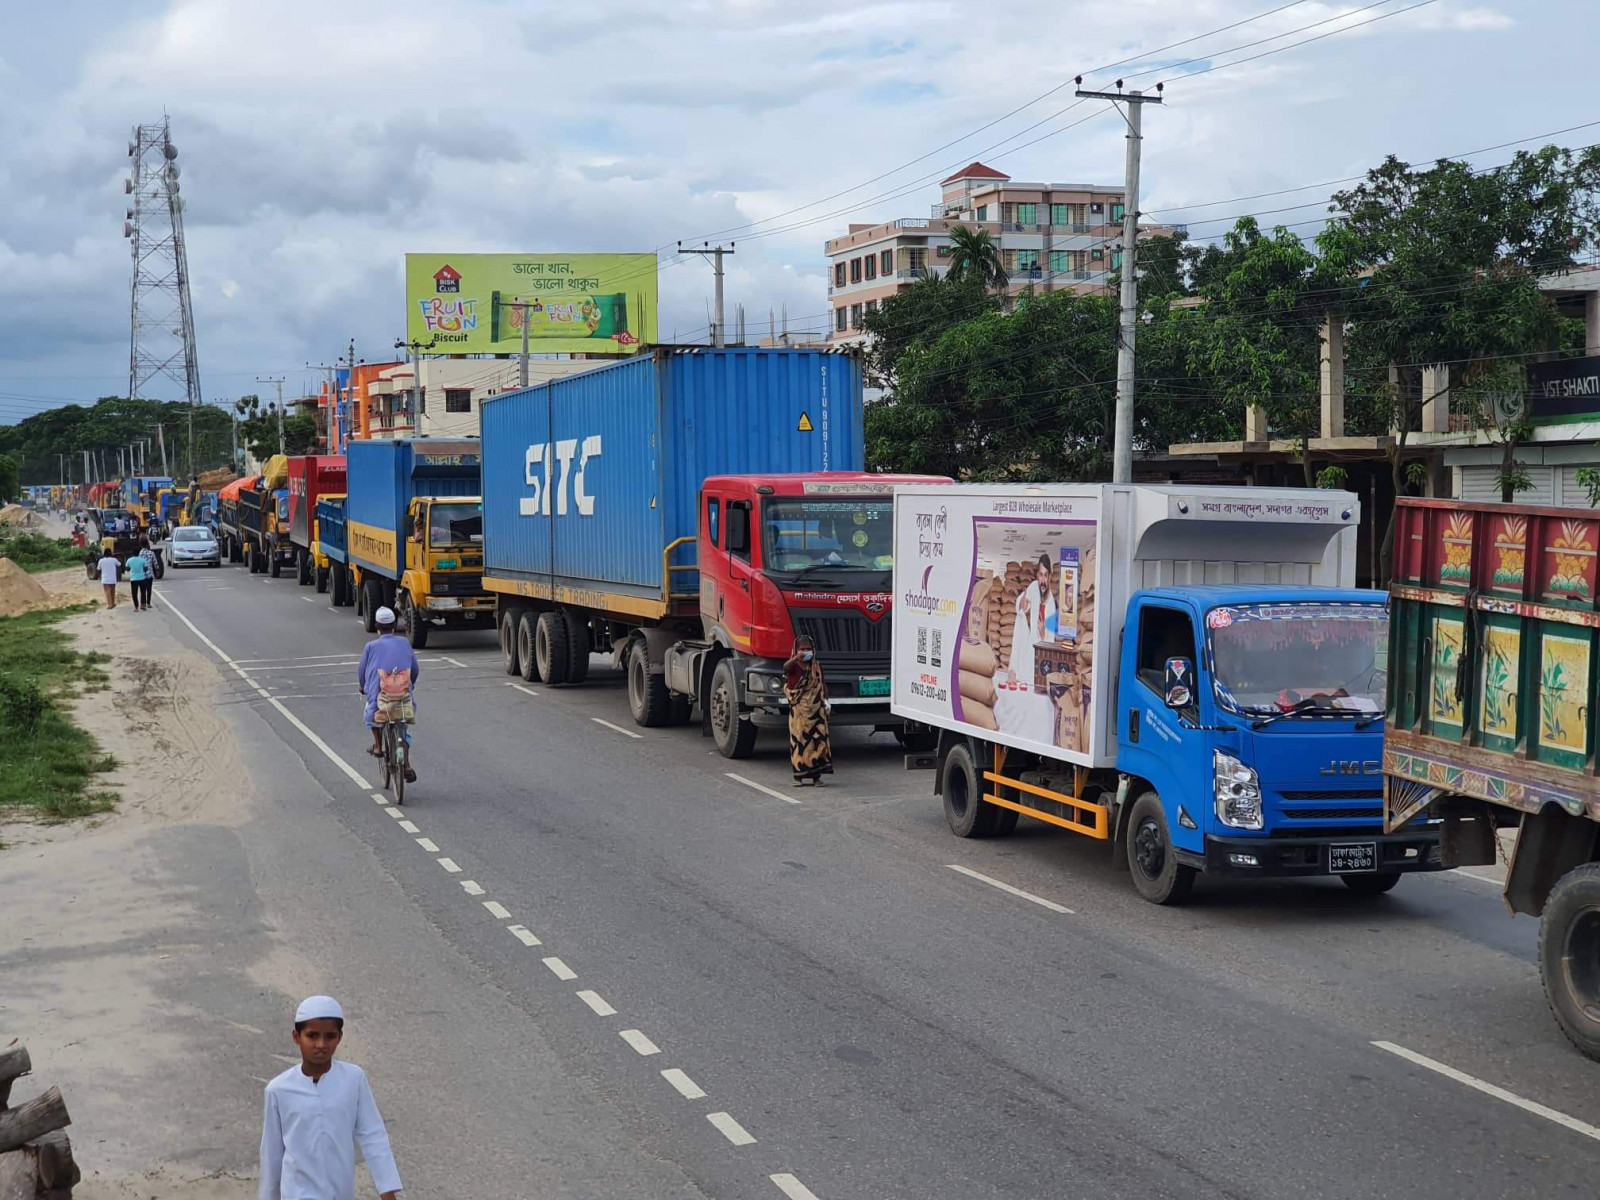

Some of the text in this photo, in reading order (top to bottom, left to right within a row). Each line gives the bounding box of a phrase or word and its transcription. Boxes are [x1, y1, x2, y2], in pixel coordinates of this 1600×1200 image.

[512, 263, 574, 275] ভালো খান,
[533, 278, 599, 292] ভালো থাকুন
[419, 297, 478, 316] FRUIT
[424, 314, 478, 332] FUN
[433, 332, 468, 342] Biscuit
[1542, 376, 1599, 397] VST SHAKTI
[520, 435, 602, 516] SITC
[992, 501, 1009, 515] Largest
[1019, 501, 1042, 513] Wholesale
[1043, 501, 1073, 516] Marketplace
[1201, 503, 1221, 513] সমগ্র
[904, 589, 957, 615] shodagor.com
[1320, 760, 1383, 775] JMC
